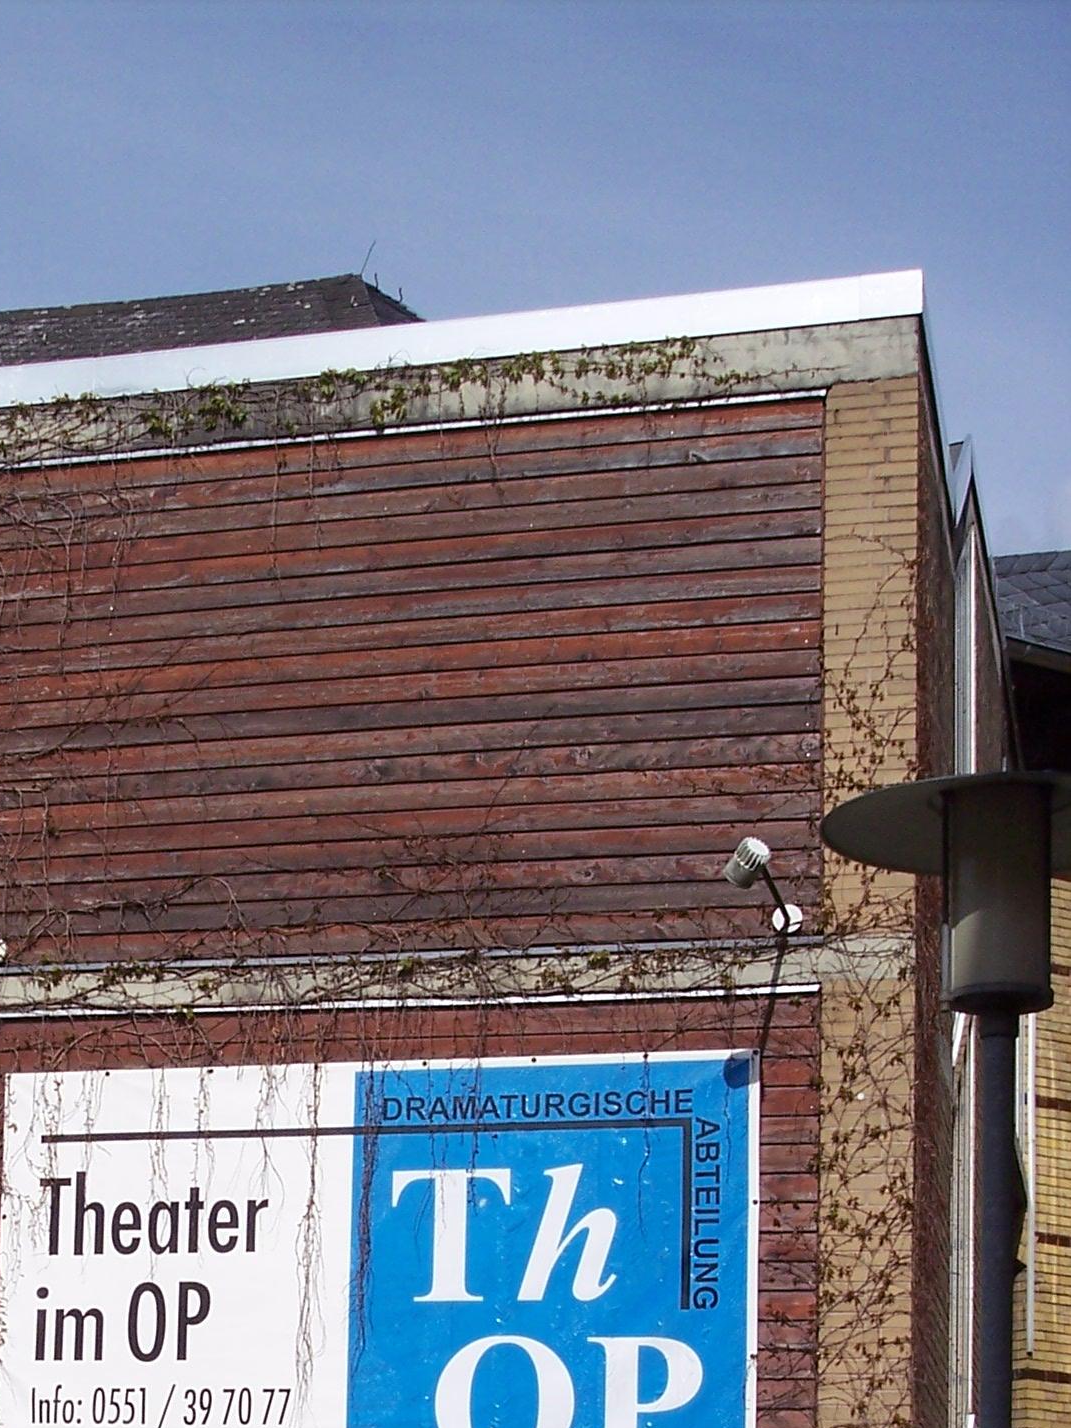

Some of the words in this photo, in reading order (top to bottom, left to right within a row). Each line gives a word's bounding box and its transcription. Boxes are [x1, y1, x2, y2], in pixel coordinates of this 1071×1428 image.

[383, 1088, 694, 1121] DRAMATURGISCHE
[40, 1171, 269, 1256] Theater
[391, 1163, 618, 1302] Th
[693, 1116, 720, 1311] ABTEILUNG
[34, 1286, 104, 1361] im
[127, 1281, 211, 1363] OP
[31, 1384, 82, 1425] Info:
[92, 1387, 147, 1425] 0551
[183, 1387, 211, 1426] 39
[222, 1387, 251, 1426] 70
[262, 1387, 291, 1426] 77
